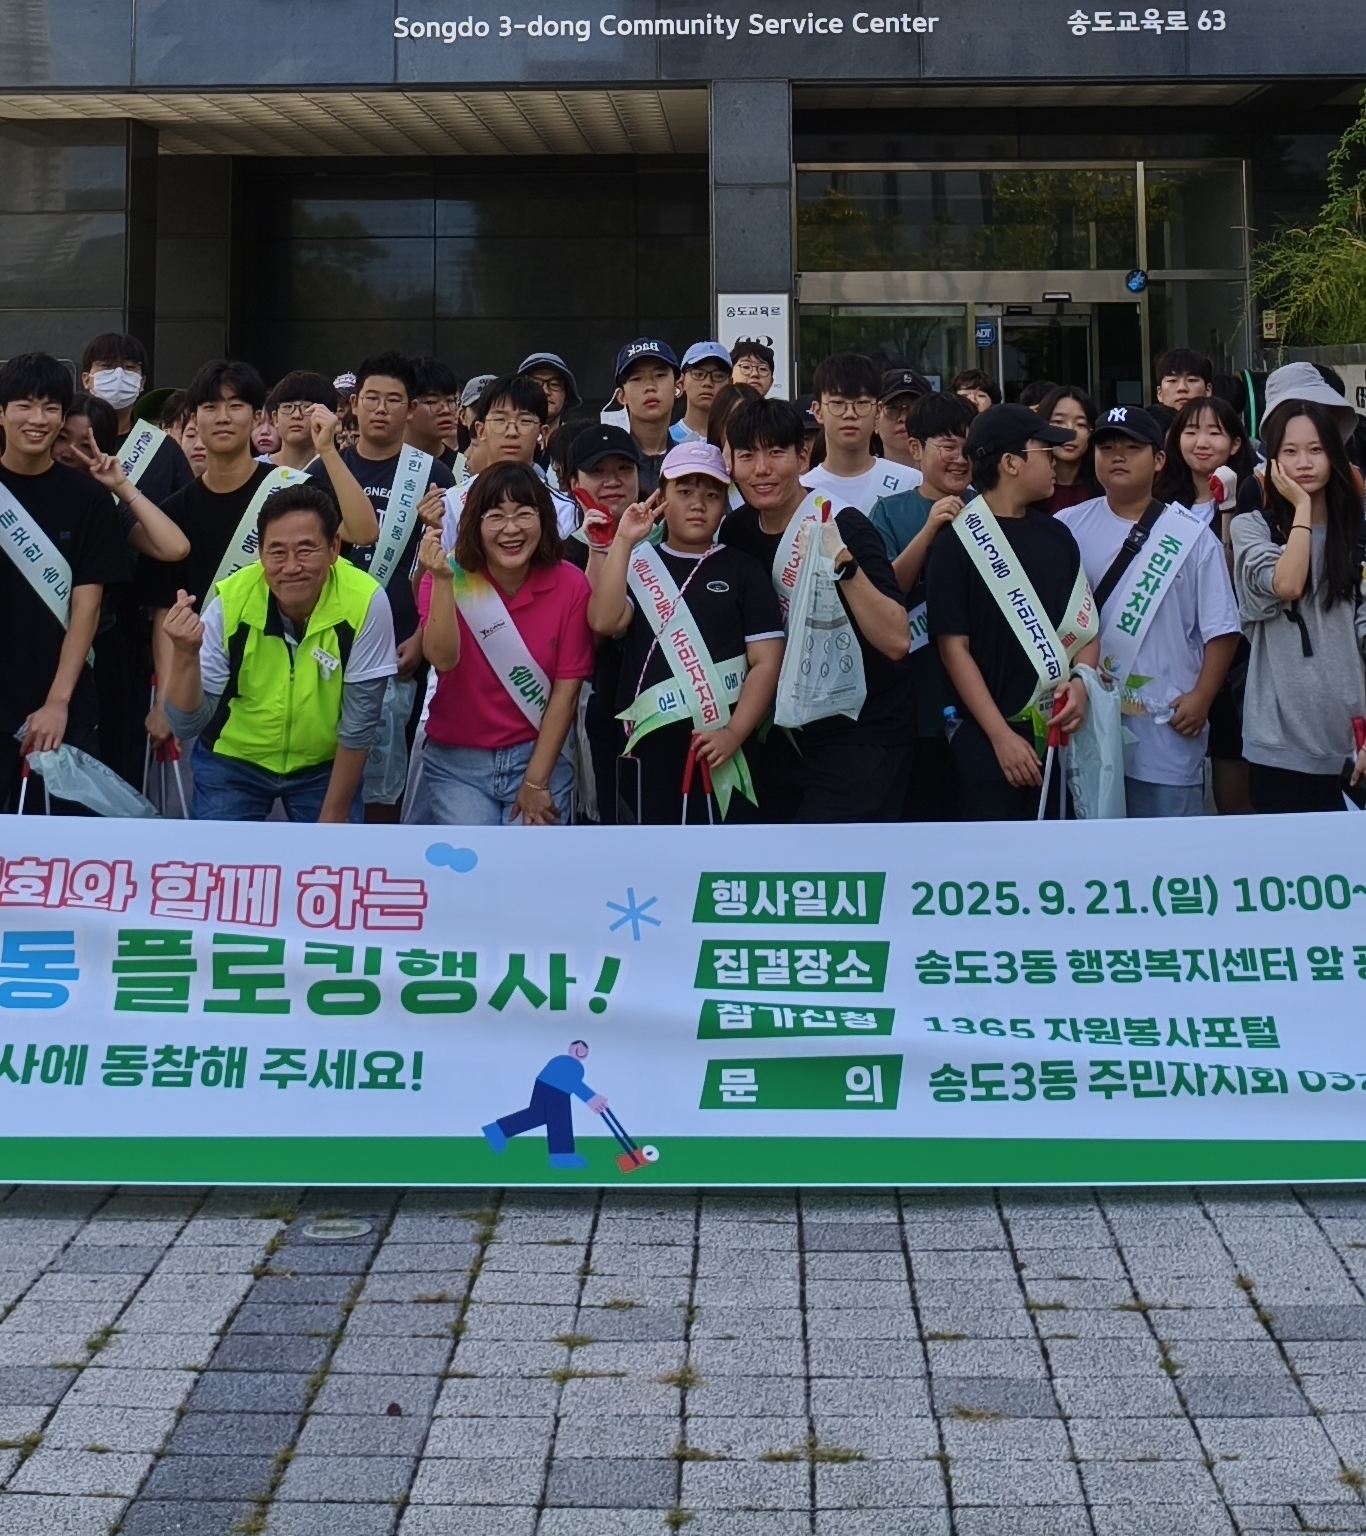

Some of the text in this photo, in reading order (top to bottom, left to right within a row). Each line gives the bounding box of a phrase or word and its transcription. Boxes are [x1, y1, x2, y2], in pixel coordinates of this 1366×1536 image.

[393, 10, 939, 42] Songdo 3-dong Community Service Center
[1066, 8, 1227, 37] 송도교육로 63
[964, 512, 1062, 681] 송도3동 주민자치회
[1116, 533, 1183, 638] 주민자치회
[671, 627, 720, 725] 주민자치회
[150, 859, 283, 927] 함께
[295, 866, 428, 931] 하는
[711, 879, 868, 917] 행사일시
[111, 927, 622, 1016] 플로킹행사!
[712, 947, 874, 986] 집결장소
[913, 948, 1058, 985] 송도3동
[1065, 944, 1299, 985] 행정복지센터
[1305, 943, 1344, 982] 앞
[716, 1001, 879, 1031] 참가신청
[922, 1014, 1281, 1049] 1365 자원봉사포털
[100, 1043, 249, 1089] 동참해
[259, 1048, 424, 1092] 주세요!
[718, 1065, 884, 1104] 문 의
[928, 1060, 1079, 1103] 송도3동
[1087, 1059, 1289, 1101] 주민자치회
